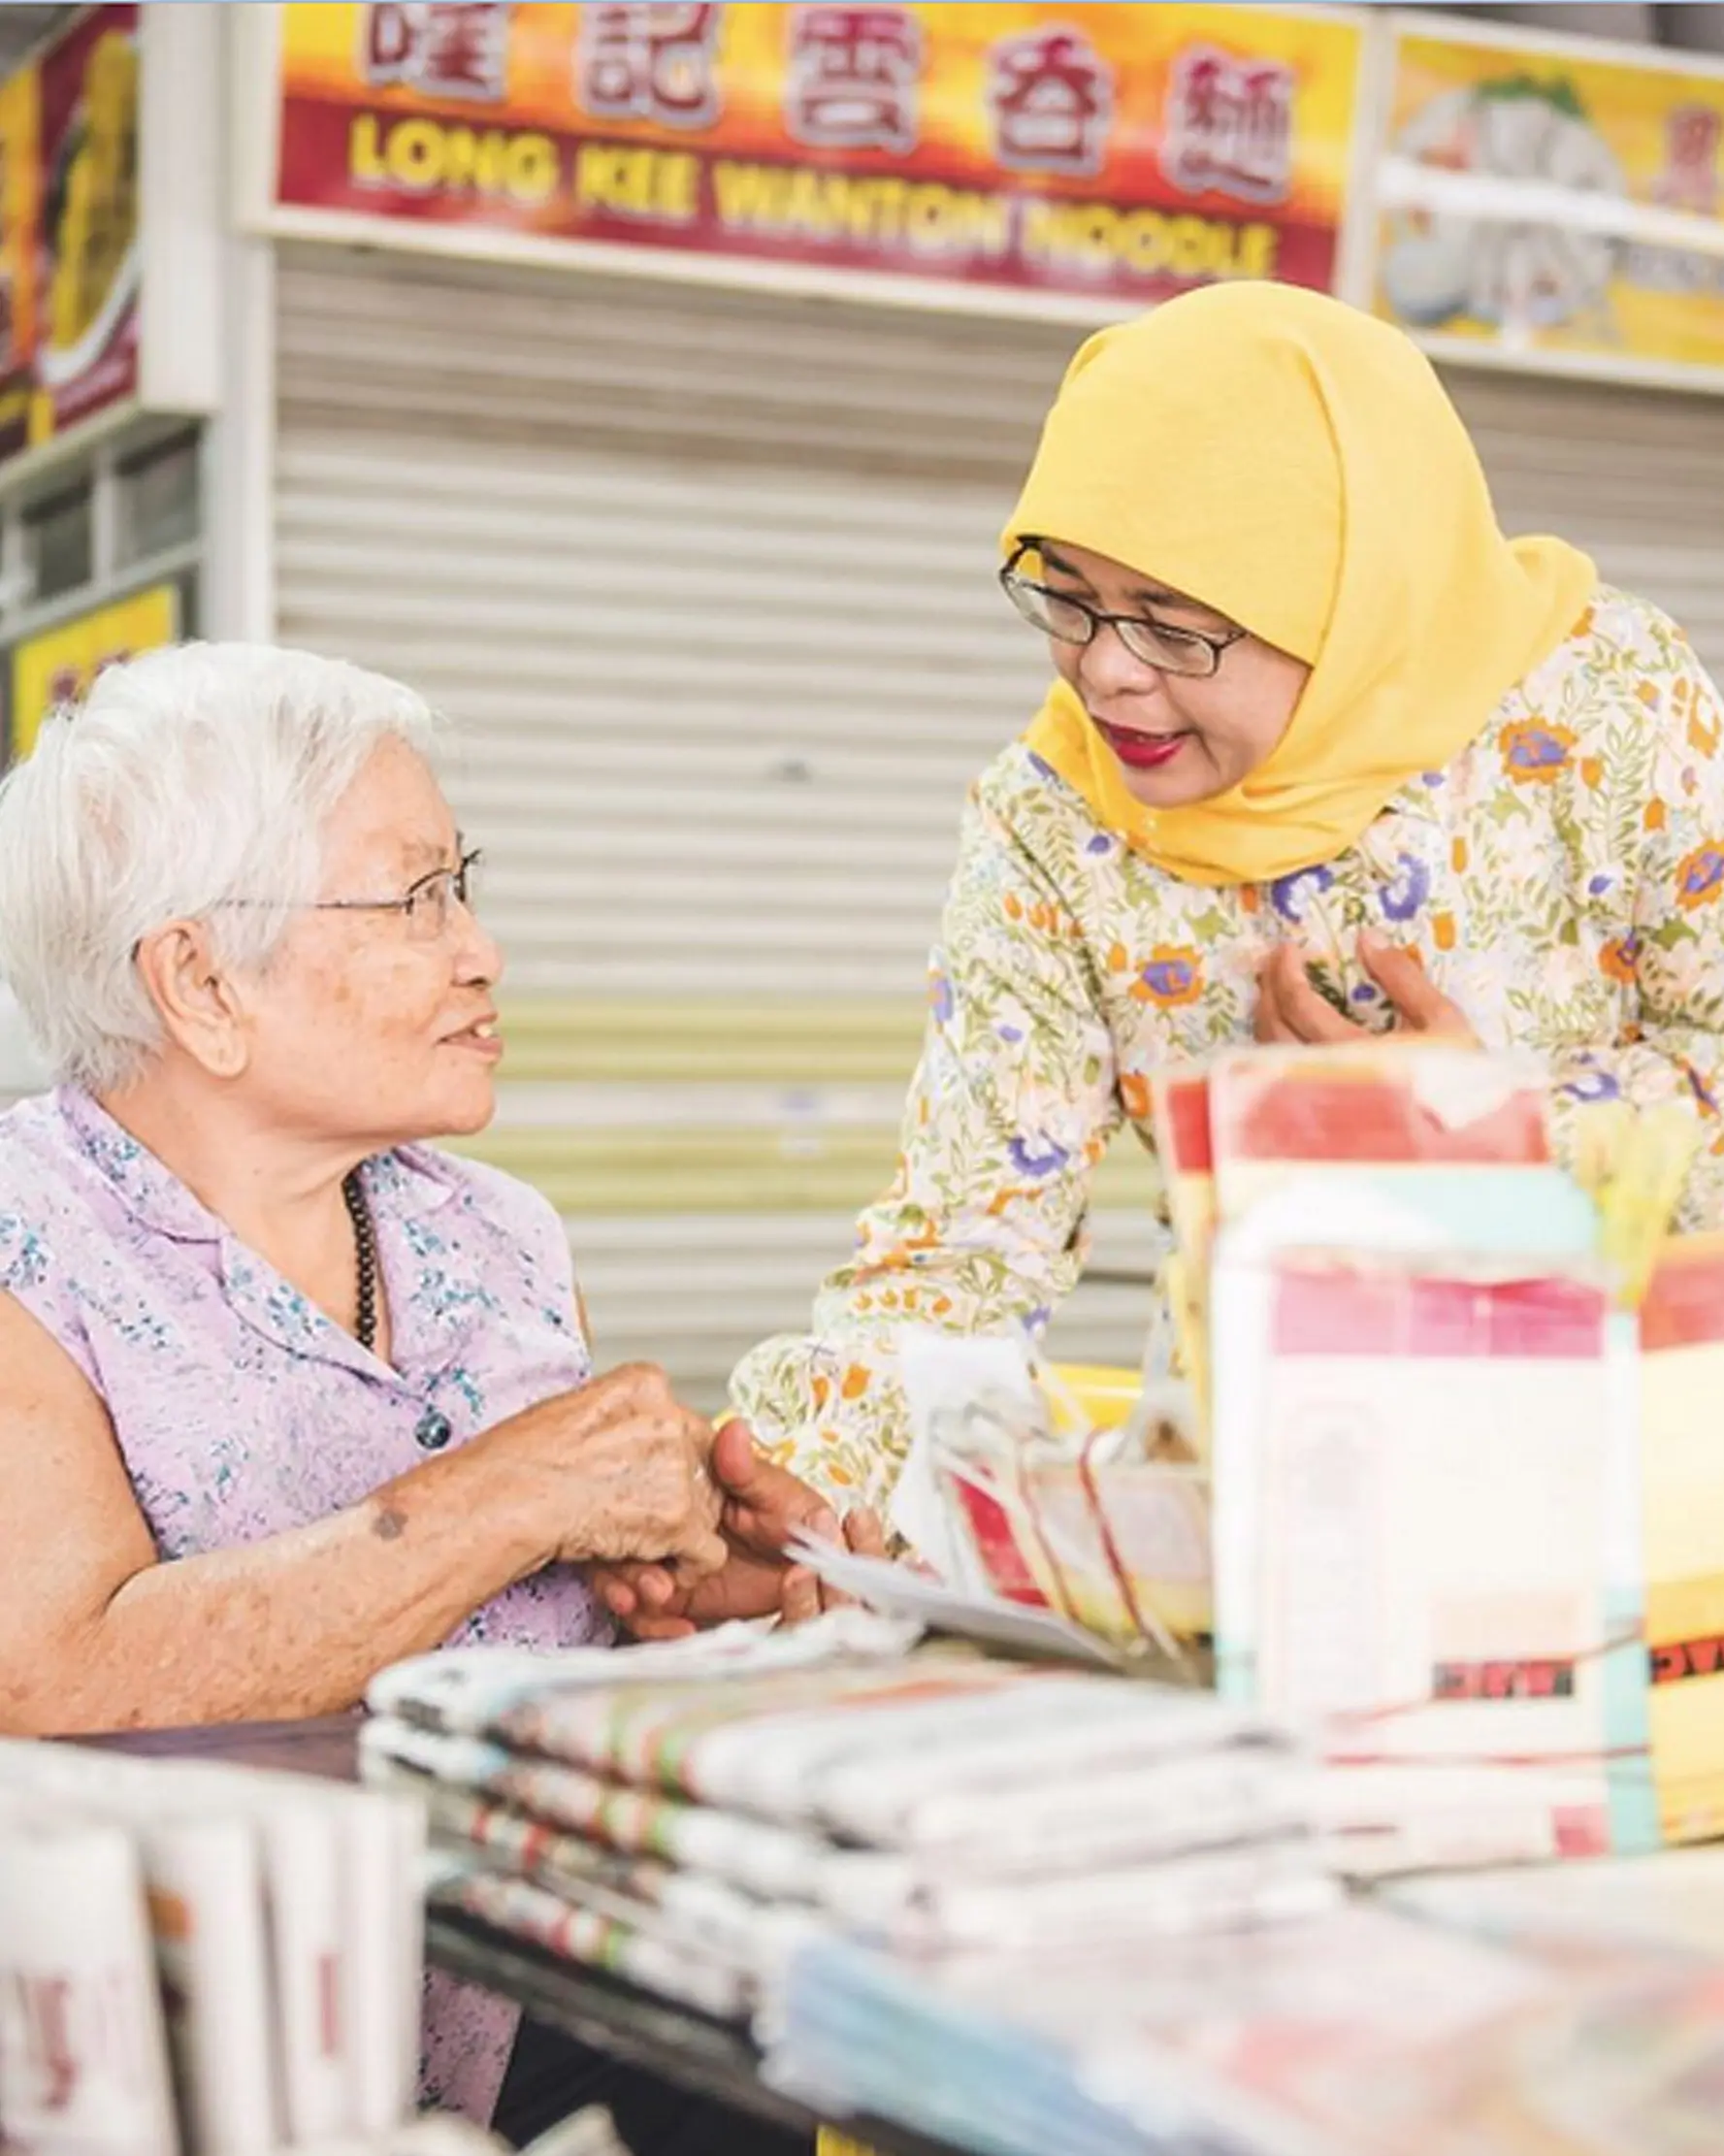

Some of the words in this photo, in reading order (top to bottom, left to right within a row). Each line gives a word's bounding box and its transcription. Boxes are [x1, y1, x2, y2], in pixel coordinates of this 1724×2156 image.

[350, 114, 558, 202] LONG
[576, 143, 699, 218] KEE
[713, 160, 1010, 258] WANTON
[1021, 197, 1278, 278] NOODLE
